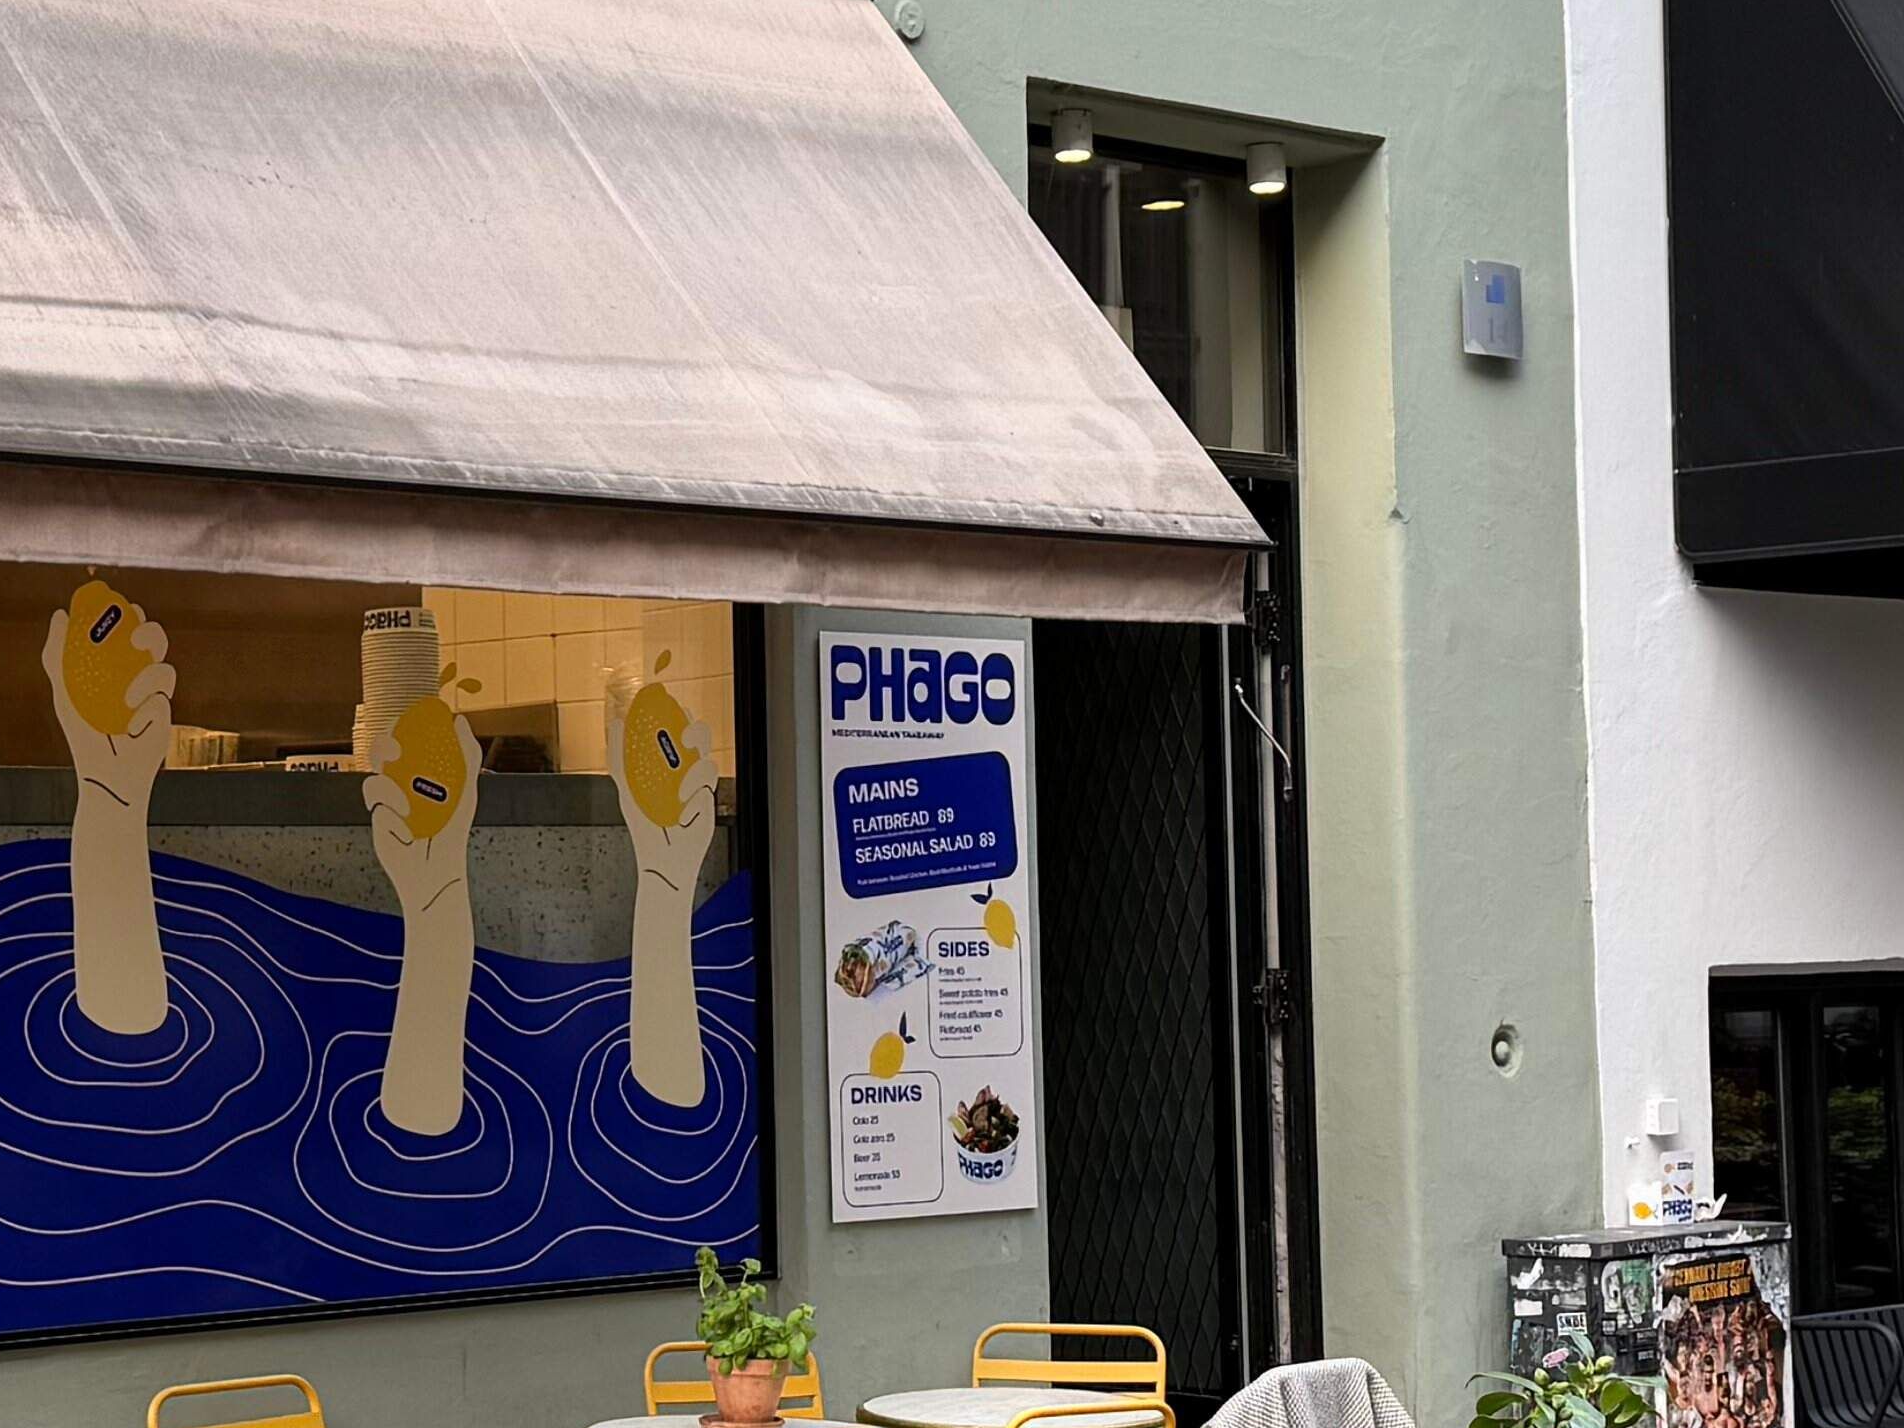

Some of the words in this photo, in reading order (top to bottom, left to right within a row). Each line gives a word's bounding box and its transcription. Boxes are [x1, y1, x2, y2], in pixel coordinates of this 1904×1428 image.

[848, 777, 920, 804] MAINS
[852, 810, 930, 834] FLATBREAD
[937, 807, 955, 824] 89
[855, 840, 929, 864] SEASONAL
[929, 834, 973, 854] SALAD
[979, 831, 996, 848] 89
[938, 940, 990, 958] SIDES
[851, 1084, 922, 1105] DRINKS
